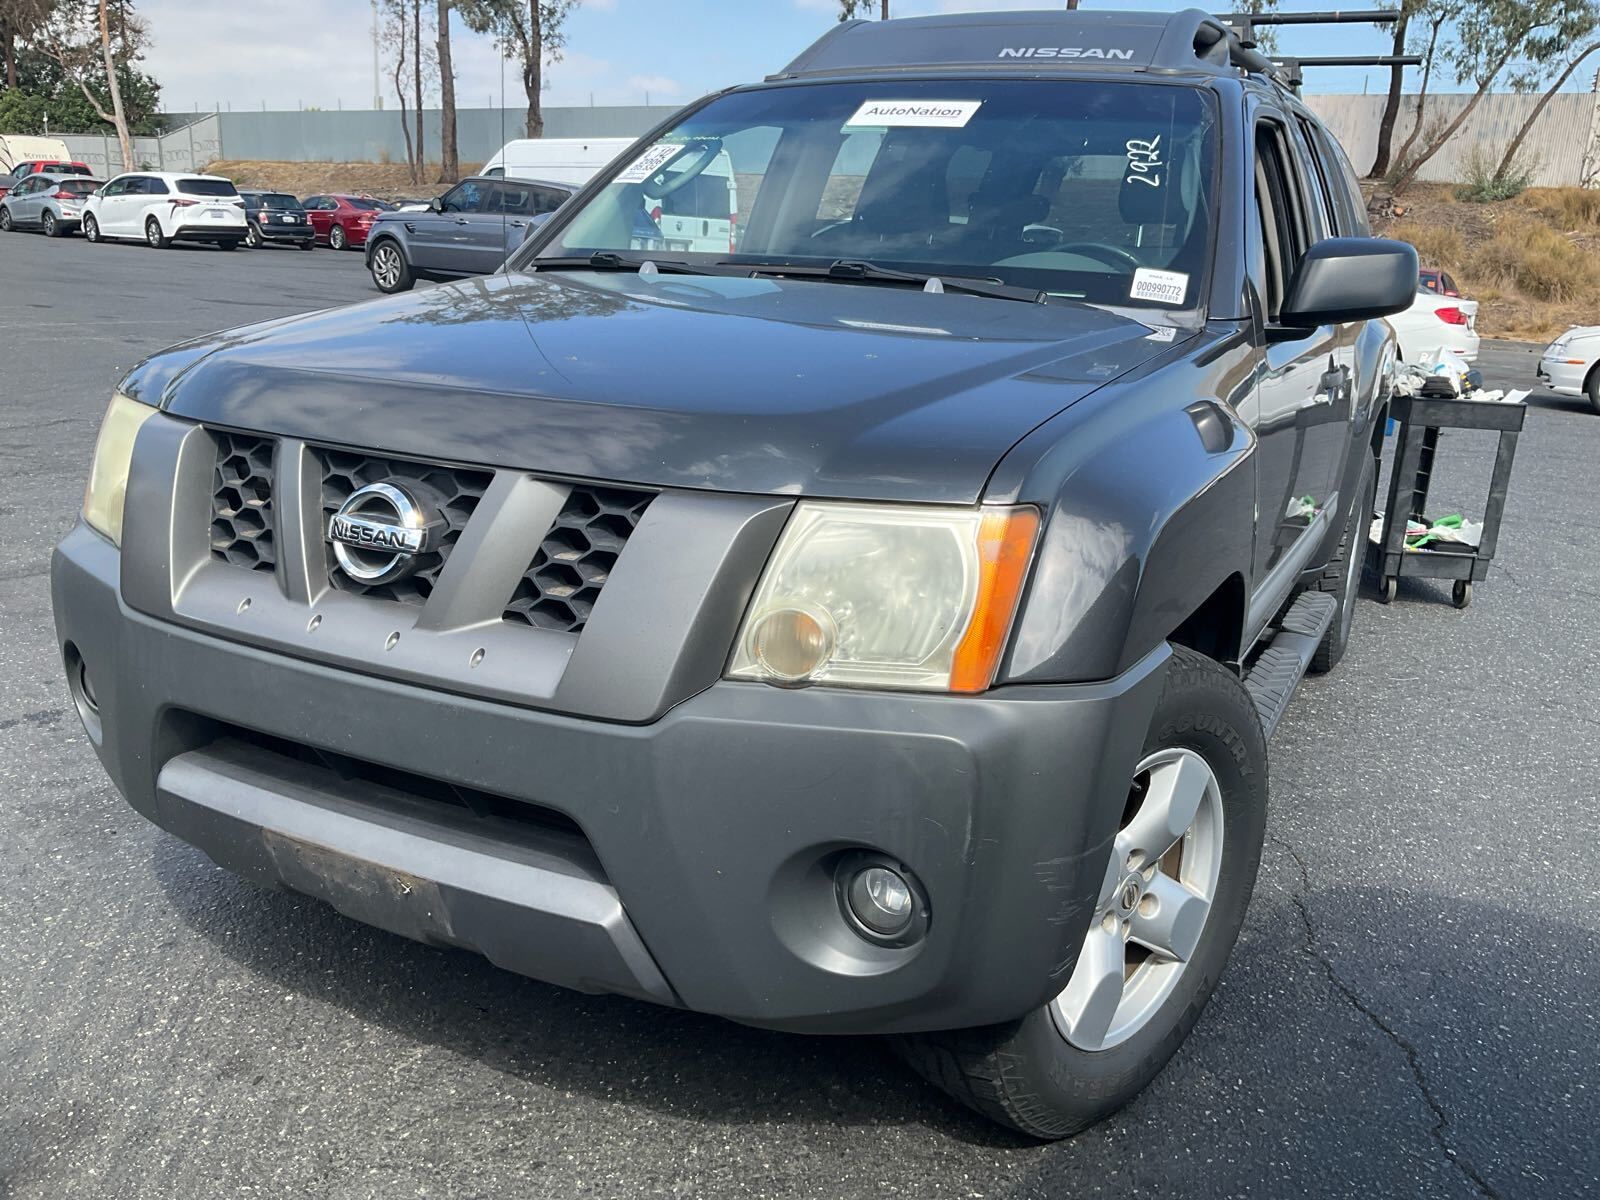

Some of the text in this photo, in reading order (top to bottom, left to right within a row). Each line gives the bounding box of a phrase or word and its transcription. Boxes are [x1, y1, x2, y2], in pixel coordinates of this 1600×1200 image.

[998, 47, 1135, 60] NISSAN
[865, 106, 963, 117] AutoNation
[1126, 134, 1163, 187] 2922
[1136, 280, 1182, 296] 000990772
[331, 519, 407, 549] NISSAN
[1159, 713, 1256, 777] COUNTRY
